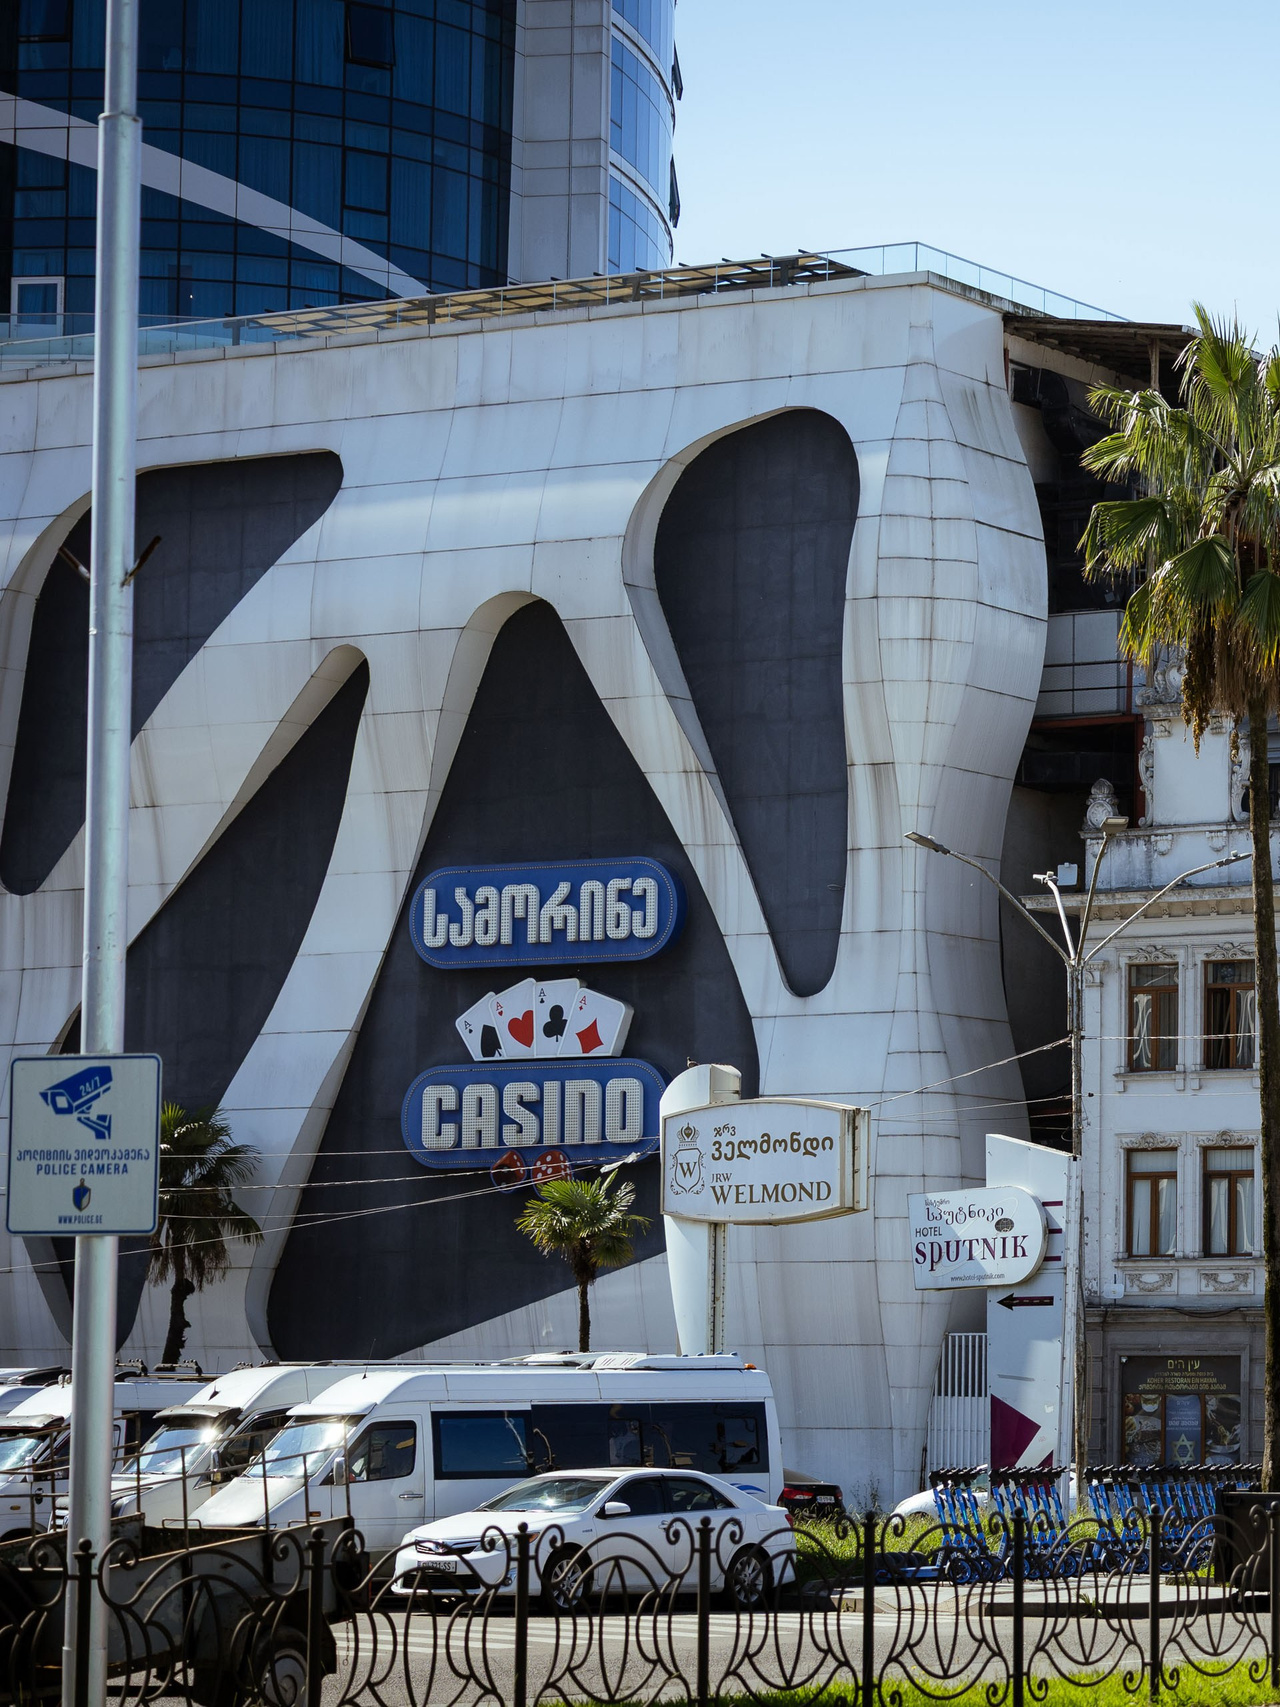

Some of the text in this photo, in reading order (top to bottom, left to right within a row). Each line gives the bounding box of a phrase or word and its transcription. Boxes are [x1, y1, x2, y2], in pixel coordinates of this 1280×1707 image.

[422, 877, 659, 948] სამორინე
[538, 987, 547, 997] A
[495, 1001, 504, 1012] A
[579, 995, 588, 1006] A
[464, 1020, 472, 1031] A
[79, 1076, 101, 1097] 24/7
[421, 1077, 645, 1150] CASINO
[711, 1131, 834, 1162] ველმონდი
[16, 1148, 150, 1162] პოლიციის ვიდეოკამერა
[36, 1163, 129, 1176] POLICE CAMERA
[678, 1161, 698, 1179] W
[711, 1172, 733, 1184] JRW
[710, 1180, 832, 1205] WELMOND
[57, 1214, 103, 1225] WWW.POLICE.GE
[925, 1204, 1004, 1226] სპუტნიკი
[915, 1226, 943, 1238] HOTEL
[914, 1234, 1029, 1272] SPUTNIK
[950, 1272, 1005, 1282] www.hotel-sputnik.com
[1167, 1359, 1201, 1372] עין הים
